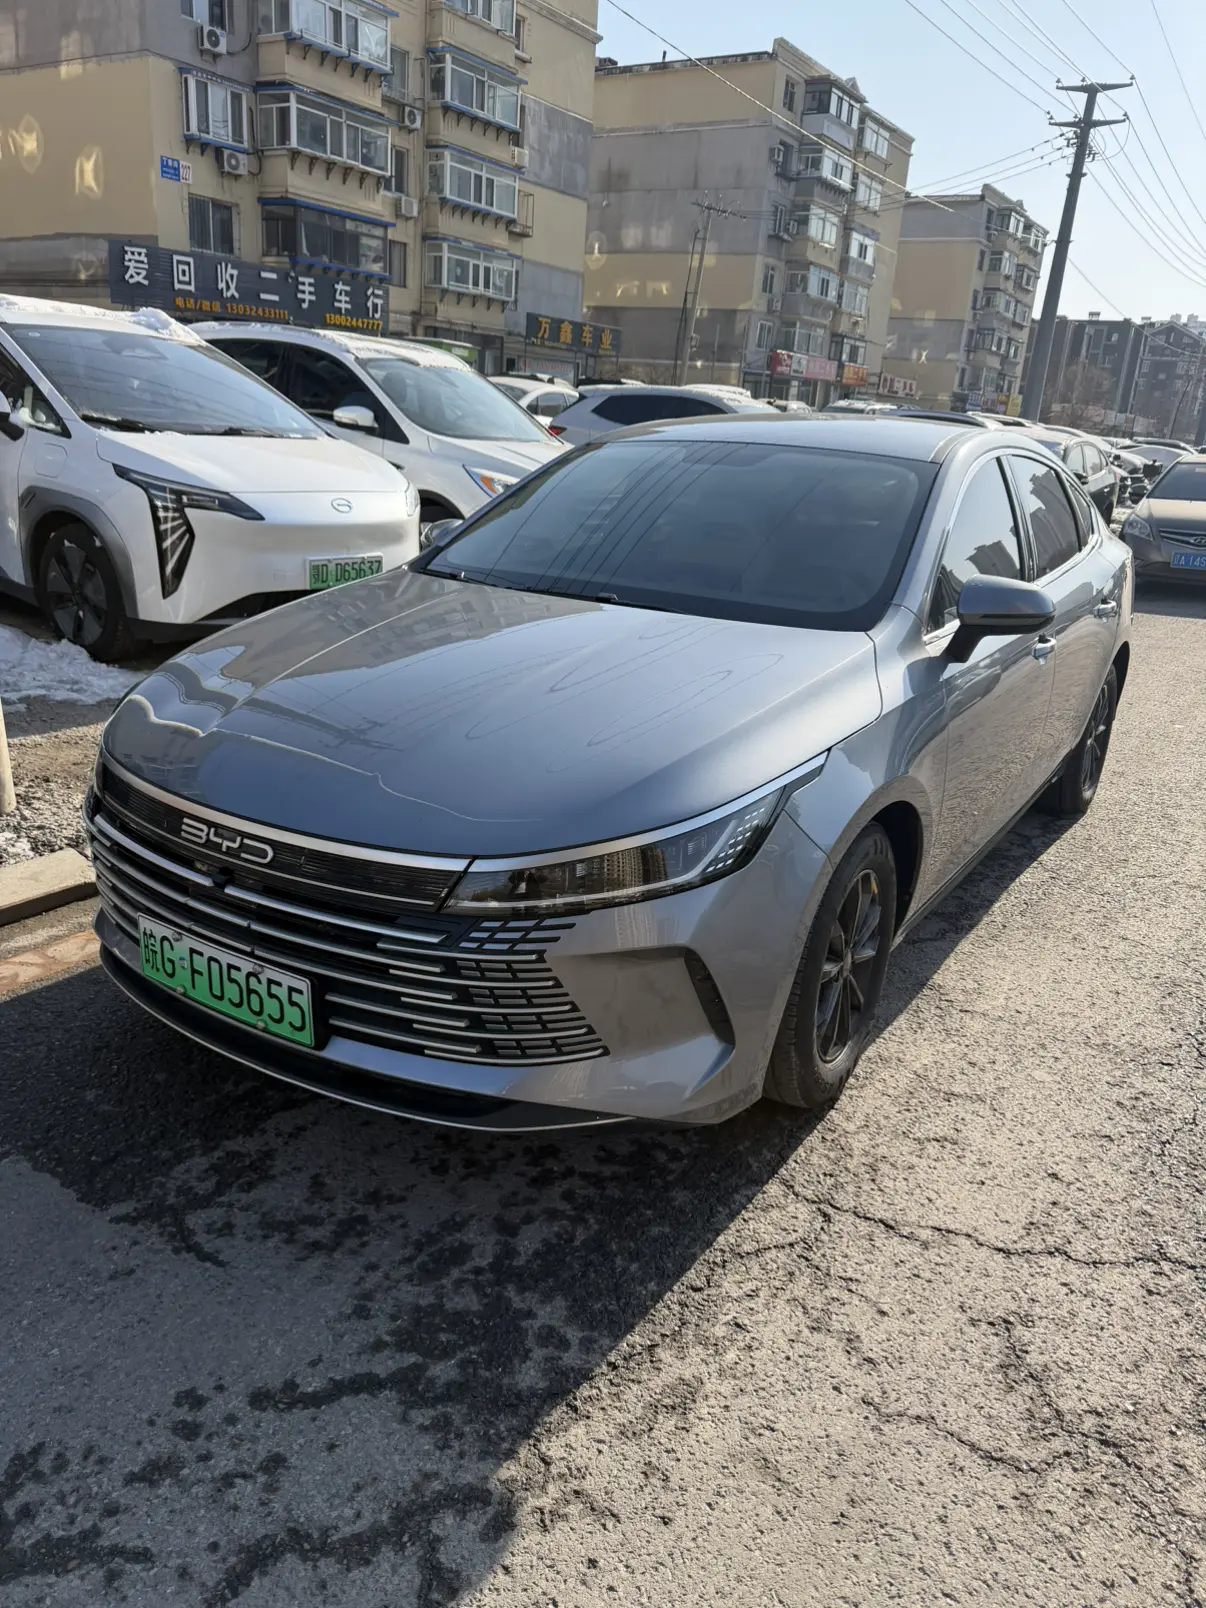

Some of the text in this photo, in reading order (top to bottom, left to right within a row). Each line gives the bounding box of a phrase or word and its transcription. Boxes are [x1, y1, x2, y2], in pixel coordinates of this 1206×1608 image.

[123, 245, 384, 319] 爱回收二手车行
[226, 303, 289, 319] 13032433111
[325, 313, 384, 330] 13002447777
[536, 317, 613, 350] 万鑫车业
[180, 817, 274, 865] BYD
